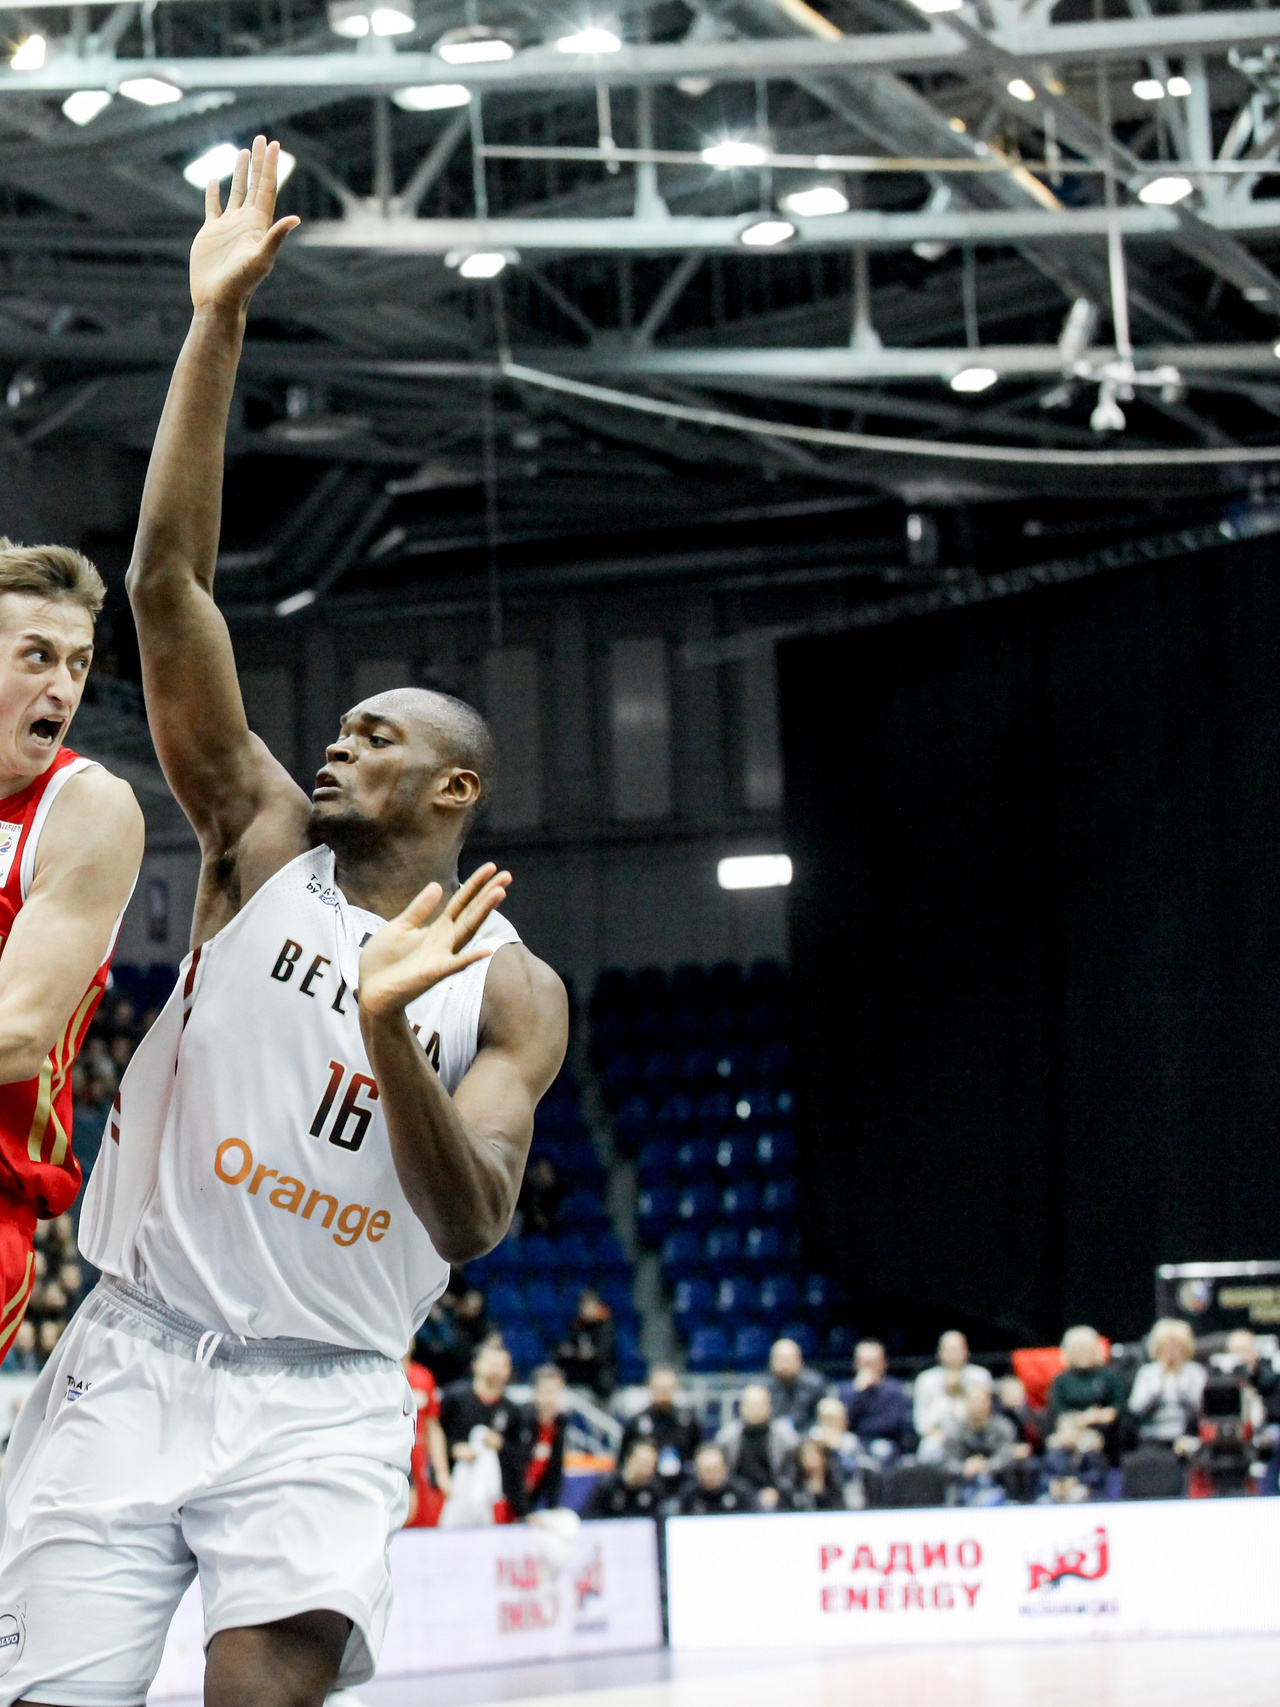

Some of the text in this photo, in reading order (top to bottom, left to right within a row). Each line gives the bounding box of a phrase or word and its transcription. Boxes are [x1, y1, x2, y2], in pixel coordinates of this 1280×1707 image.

[308, 1060, 380, 1152] 16
[214, 1137, 391, 1247] Orange
[820, 1541, 983, 1576] РАДИО
[821, 1583, 983, 1613] ENERGY
